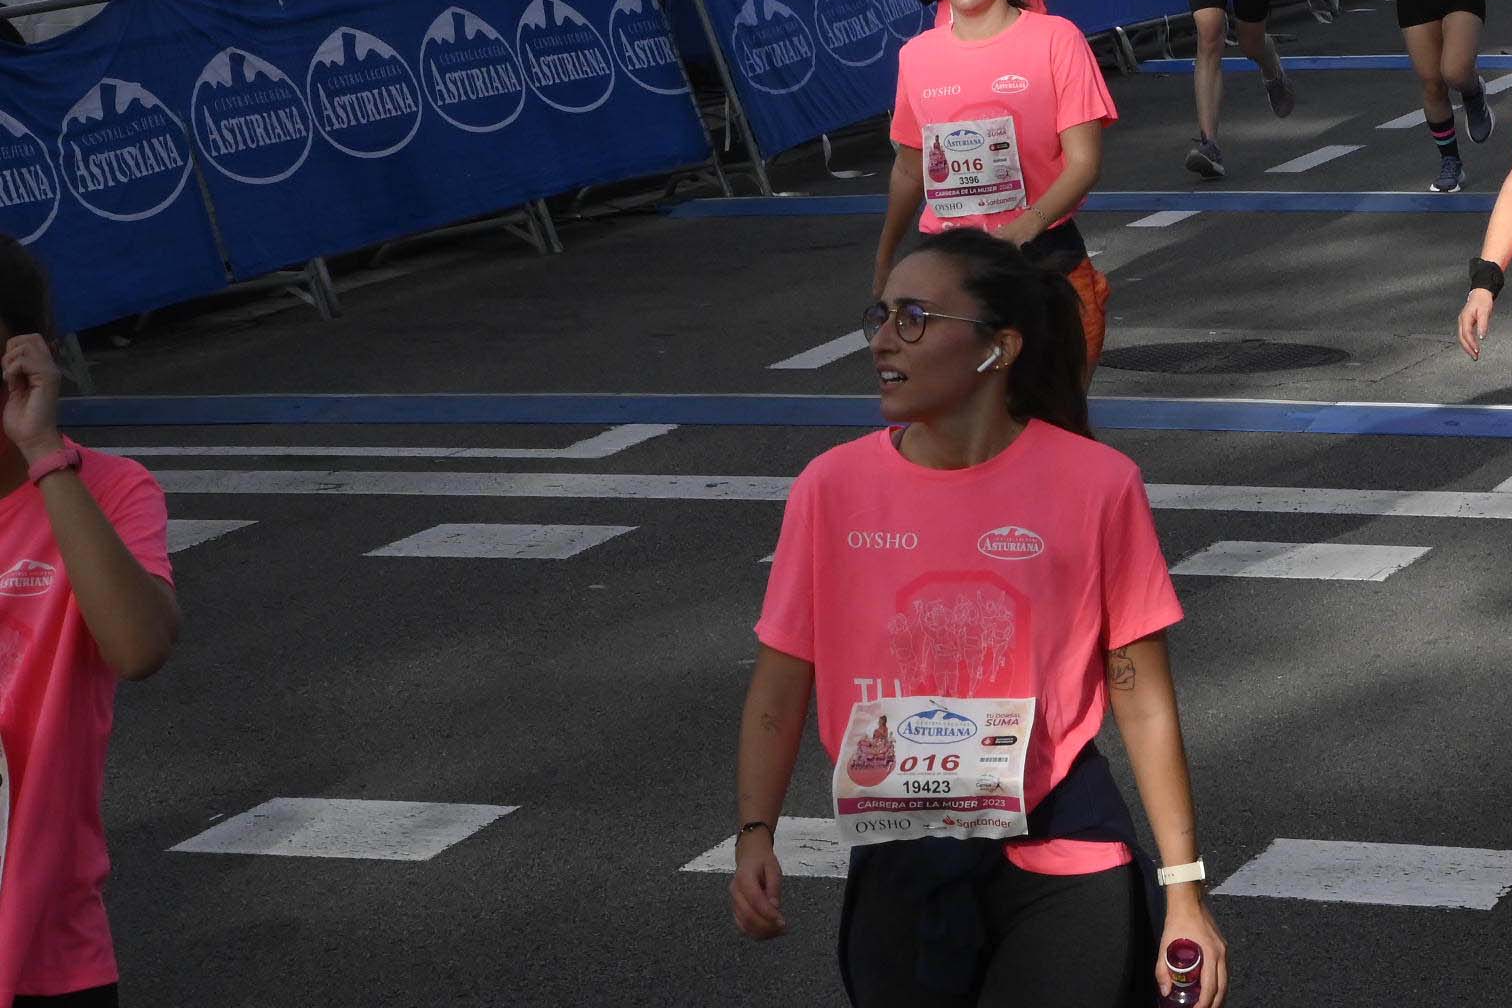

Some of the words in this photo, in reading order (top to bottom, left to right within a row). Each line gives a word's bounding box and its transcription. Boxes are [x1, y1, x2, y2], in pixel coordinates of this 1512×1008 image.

[431, 58, 521, 106] ASTURIANA
[922, 84, 961, 99] OYSHO
[318, 81, 416, 132] ASTURIANA
[203, 105, 307, 158] ASTURIANA
[70, 133, 184, 193] ASTURIANA
[951, 158, 983, 173] 016
[959, 176, 980, 185] 3396
[848, 530, 918, 550] OYSHO
[981, 537, 1039, 552] ASTURIANA
[903, 721, 971, 737] ASTURIANA
[985, 718, 1020, 728] SUMA
[900, 753, 961, 774] 016
[902, 780, 951, 795] 19423
[857, 799, 906, 809] CARRERA
[909, 799, 923, 809] DE
[926, 800, 939, 808] LA
[942, 799, 978, 809] MUJER
[982, 798, 1006, 808] 2023
[855, 818, 911, 834] OYSHO
[956, 817, 1012, 830] Santander
